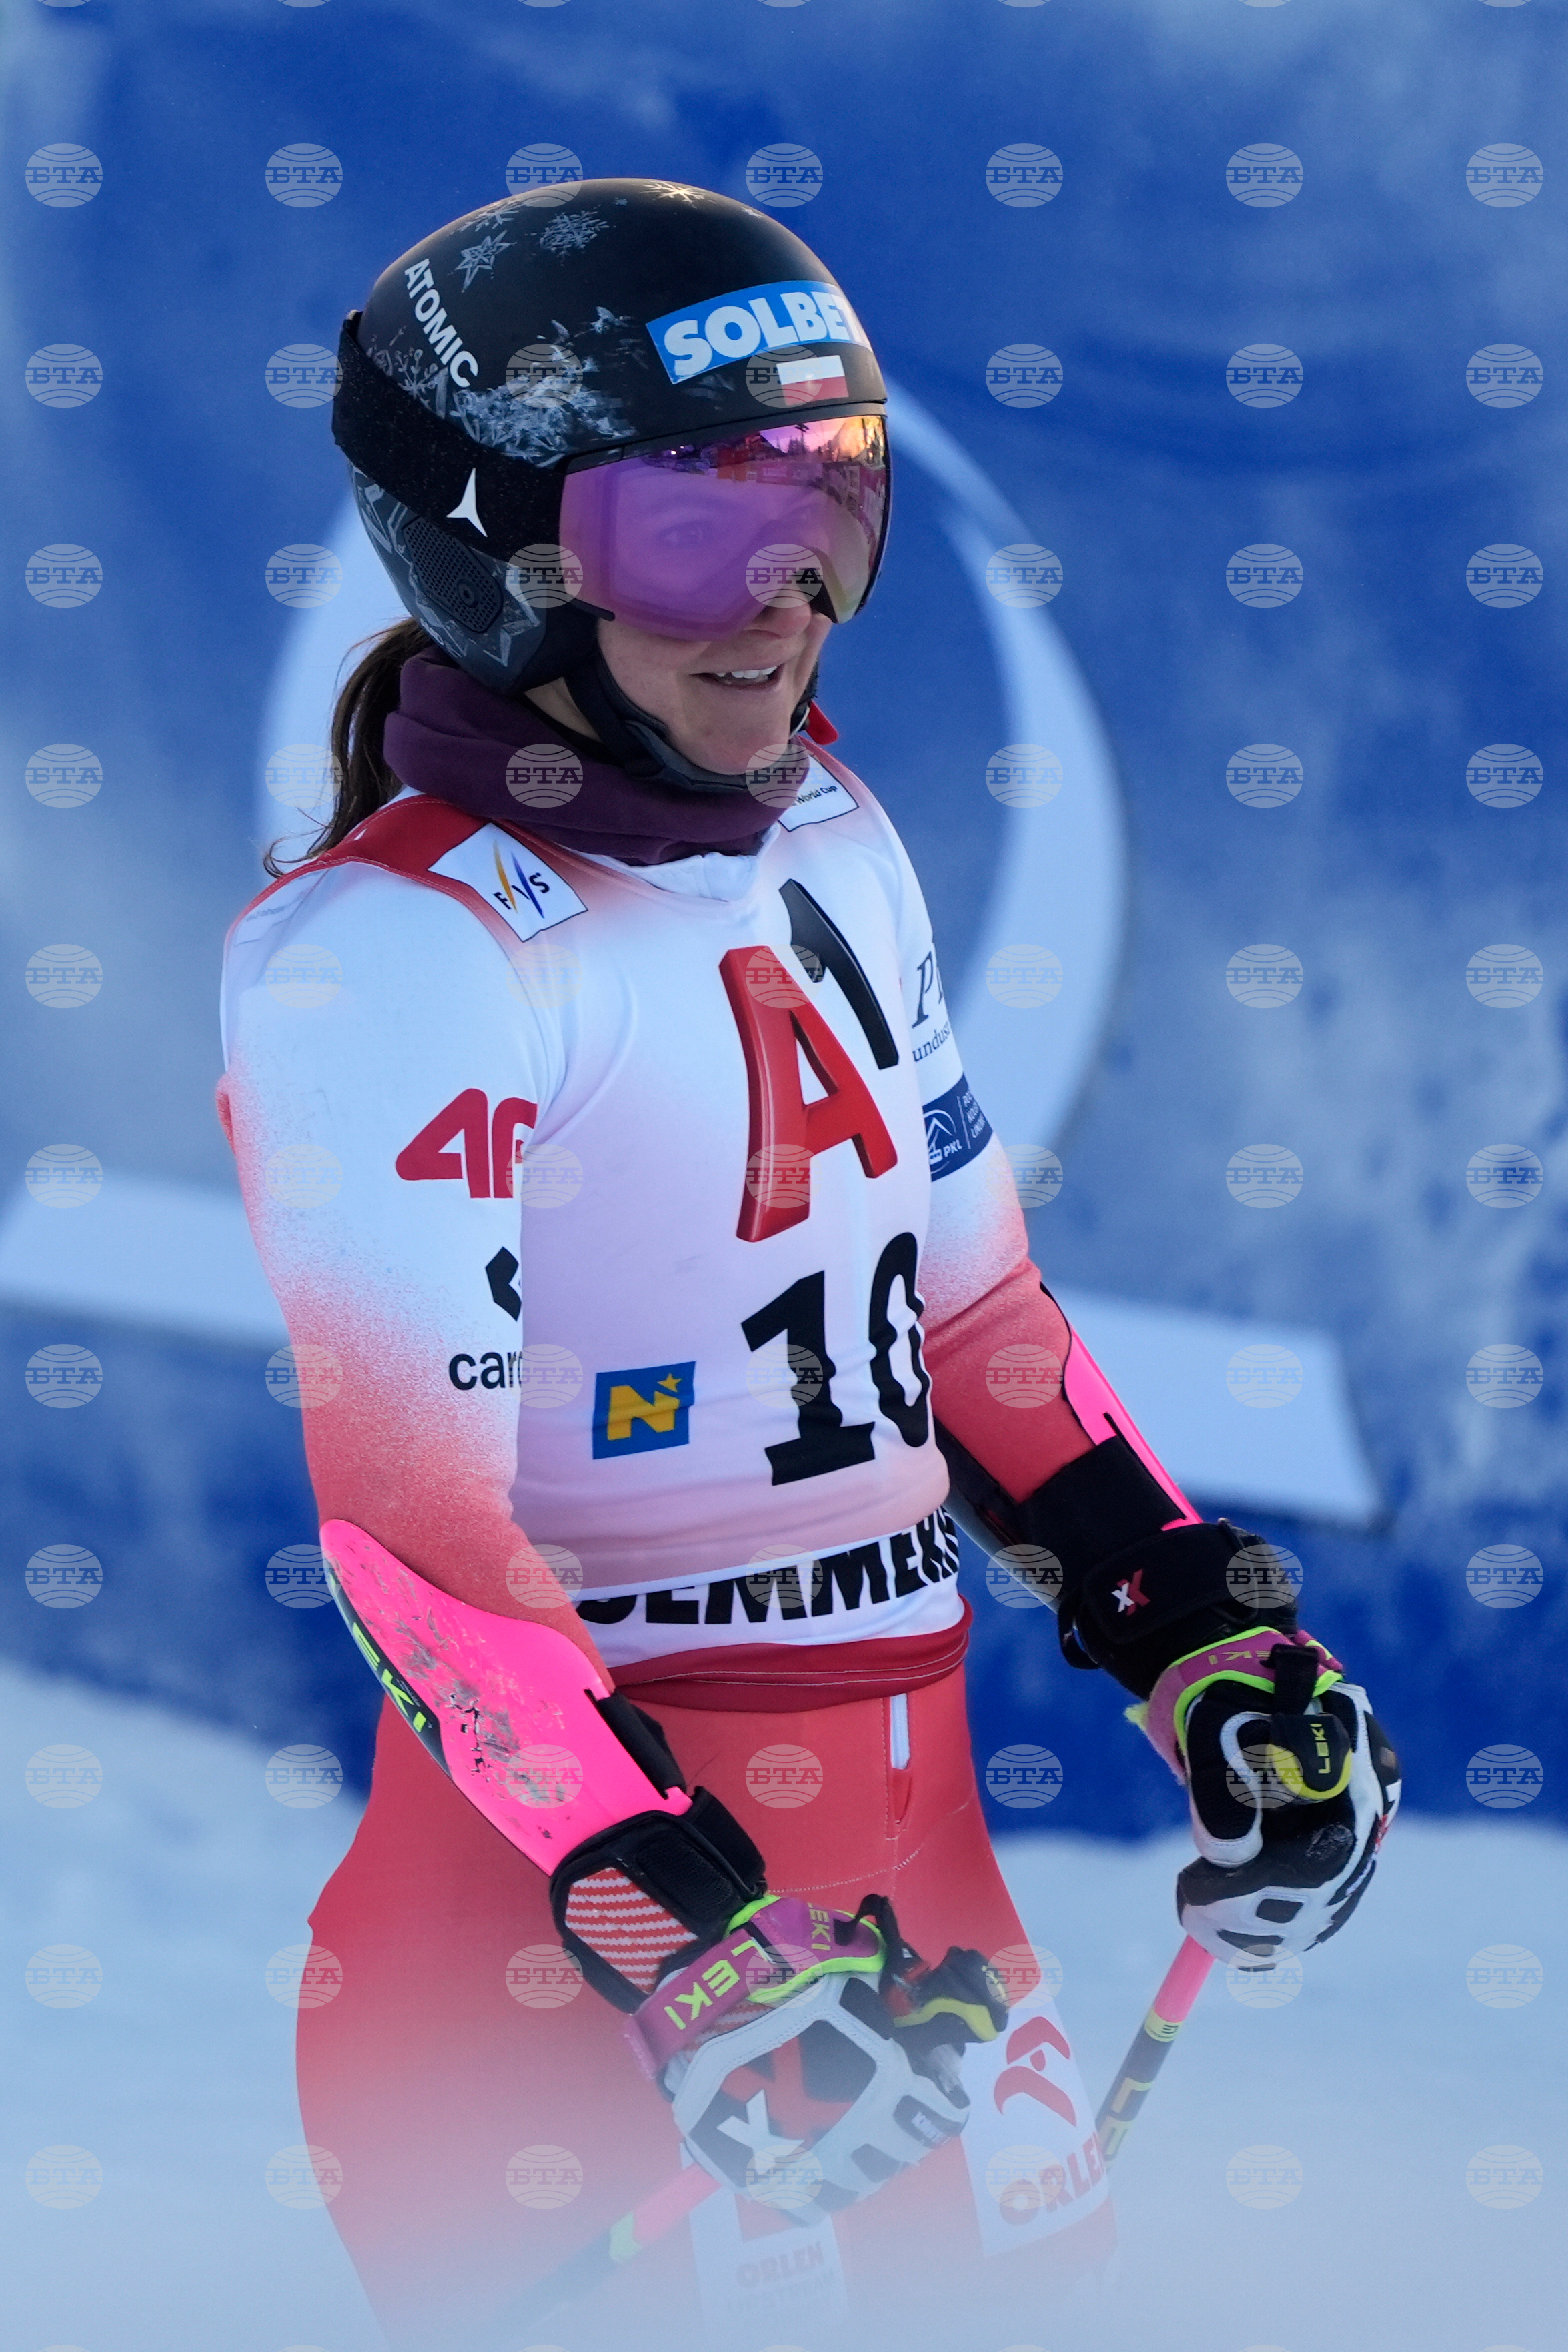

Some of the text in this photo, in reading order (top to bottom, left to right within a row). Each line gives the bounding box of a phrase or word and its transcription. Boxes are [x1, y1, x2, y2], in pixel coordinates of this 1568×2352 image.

[404, 258, 479, 388] ATOMIC
[942, 1139, 964, 1157] PKL
[448, 1351, 523, 1391] car
[740, 1231, 932, 1486] 10
[664, 1938, 776, 2031] LEKI
[736, 2240, 826, 2289] ORLEN
